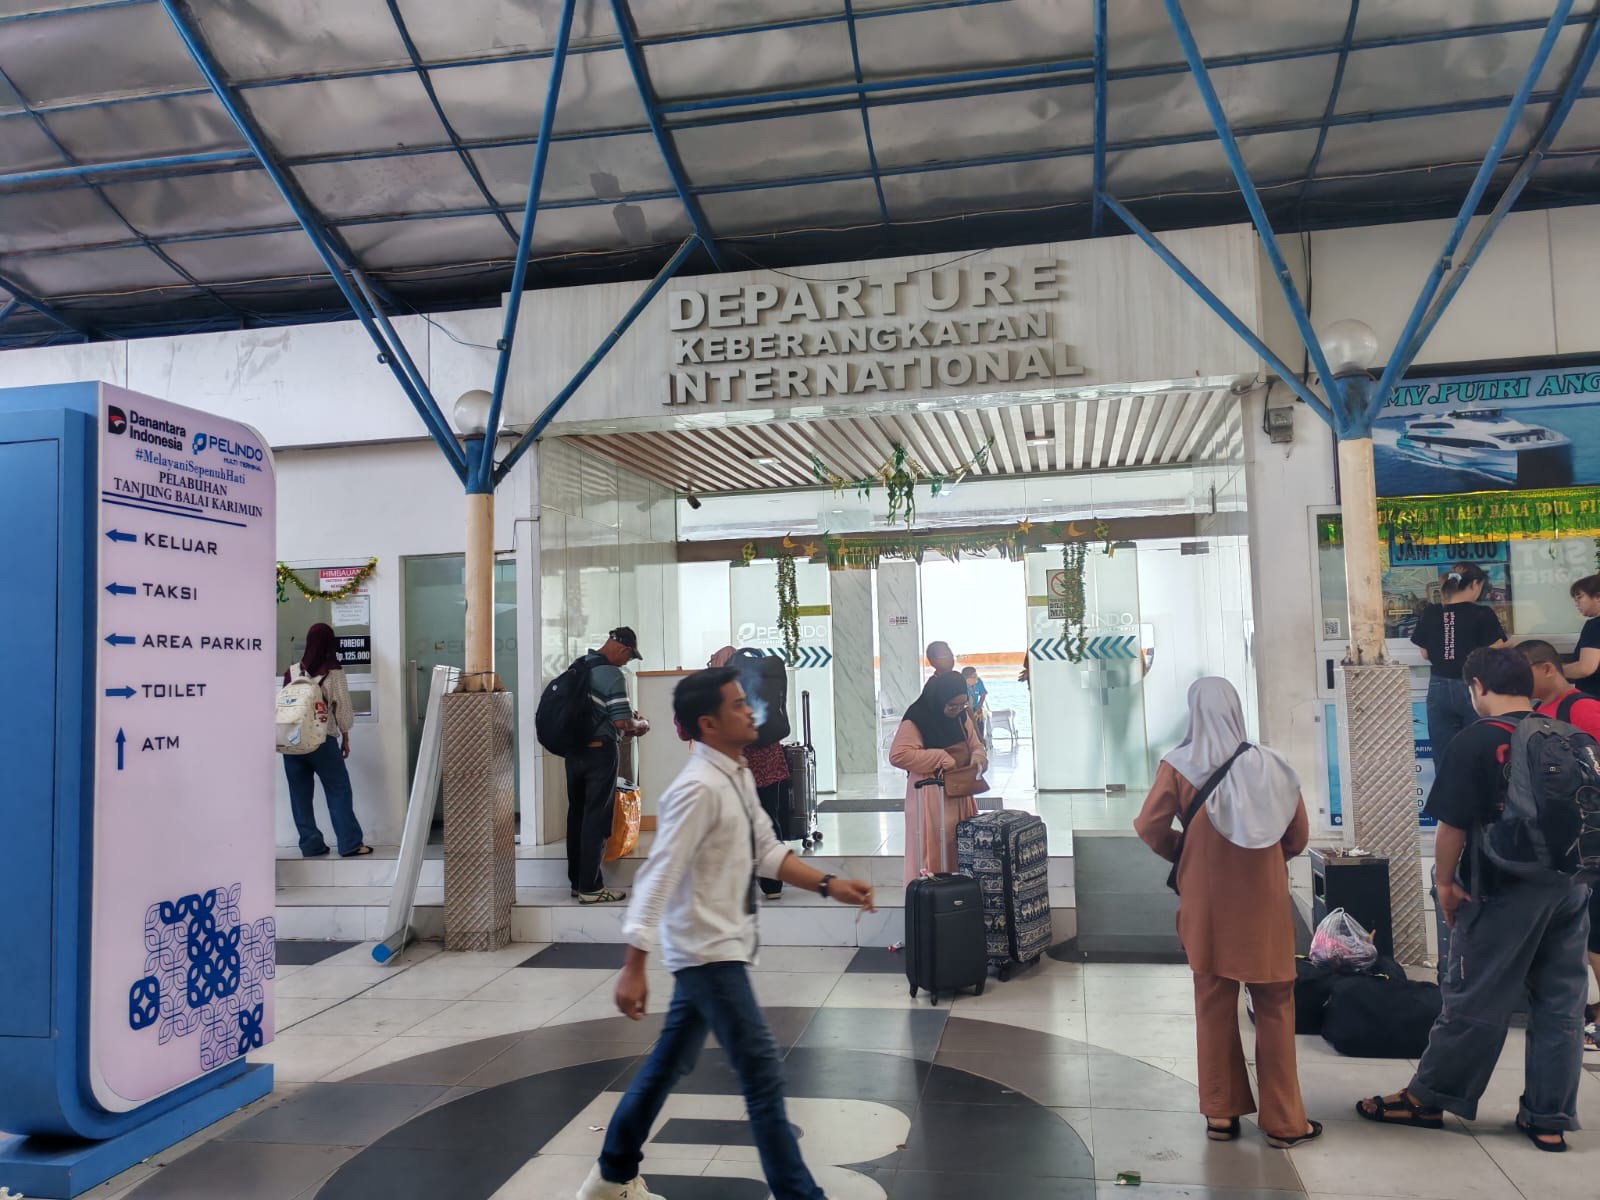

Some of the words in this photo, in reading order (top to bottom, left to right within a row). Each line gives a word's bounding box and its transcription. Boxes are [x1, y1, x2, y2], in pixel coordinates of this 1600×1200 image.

[669, 257, 1061, 331] DEPARTURE
[675, 310, 1050, 365] KEBERANGKATAN
[661, 342, 1085, 405] INTERNATIONAL
[130, 410, 186, 437] Danantara
[130, 425, 183, 451] Indonesia
[209, 435, 263, 462] PELINDO
[135, 447, 246, 485] #MelayaniSepenuhHati
[114, 477, 172, 500] TANJUNG
[175, 490, 209, 508] BALAI
[212, 499, 263, 517] KARIMUN
[159, 471, 228, 497] PELABUHAN
[144, 532, 218, 555] KELUAR
[142, 583, 198, 600] TAKSI
[142, 634, 193, 649] AREA
[201, 636, 262, 651] PARKIR
[141, 683, 207, 698] TOILET
[141, 736, 180, 751] ATM
